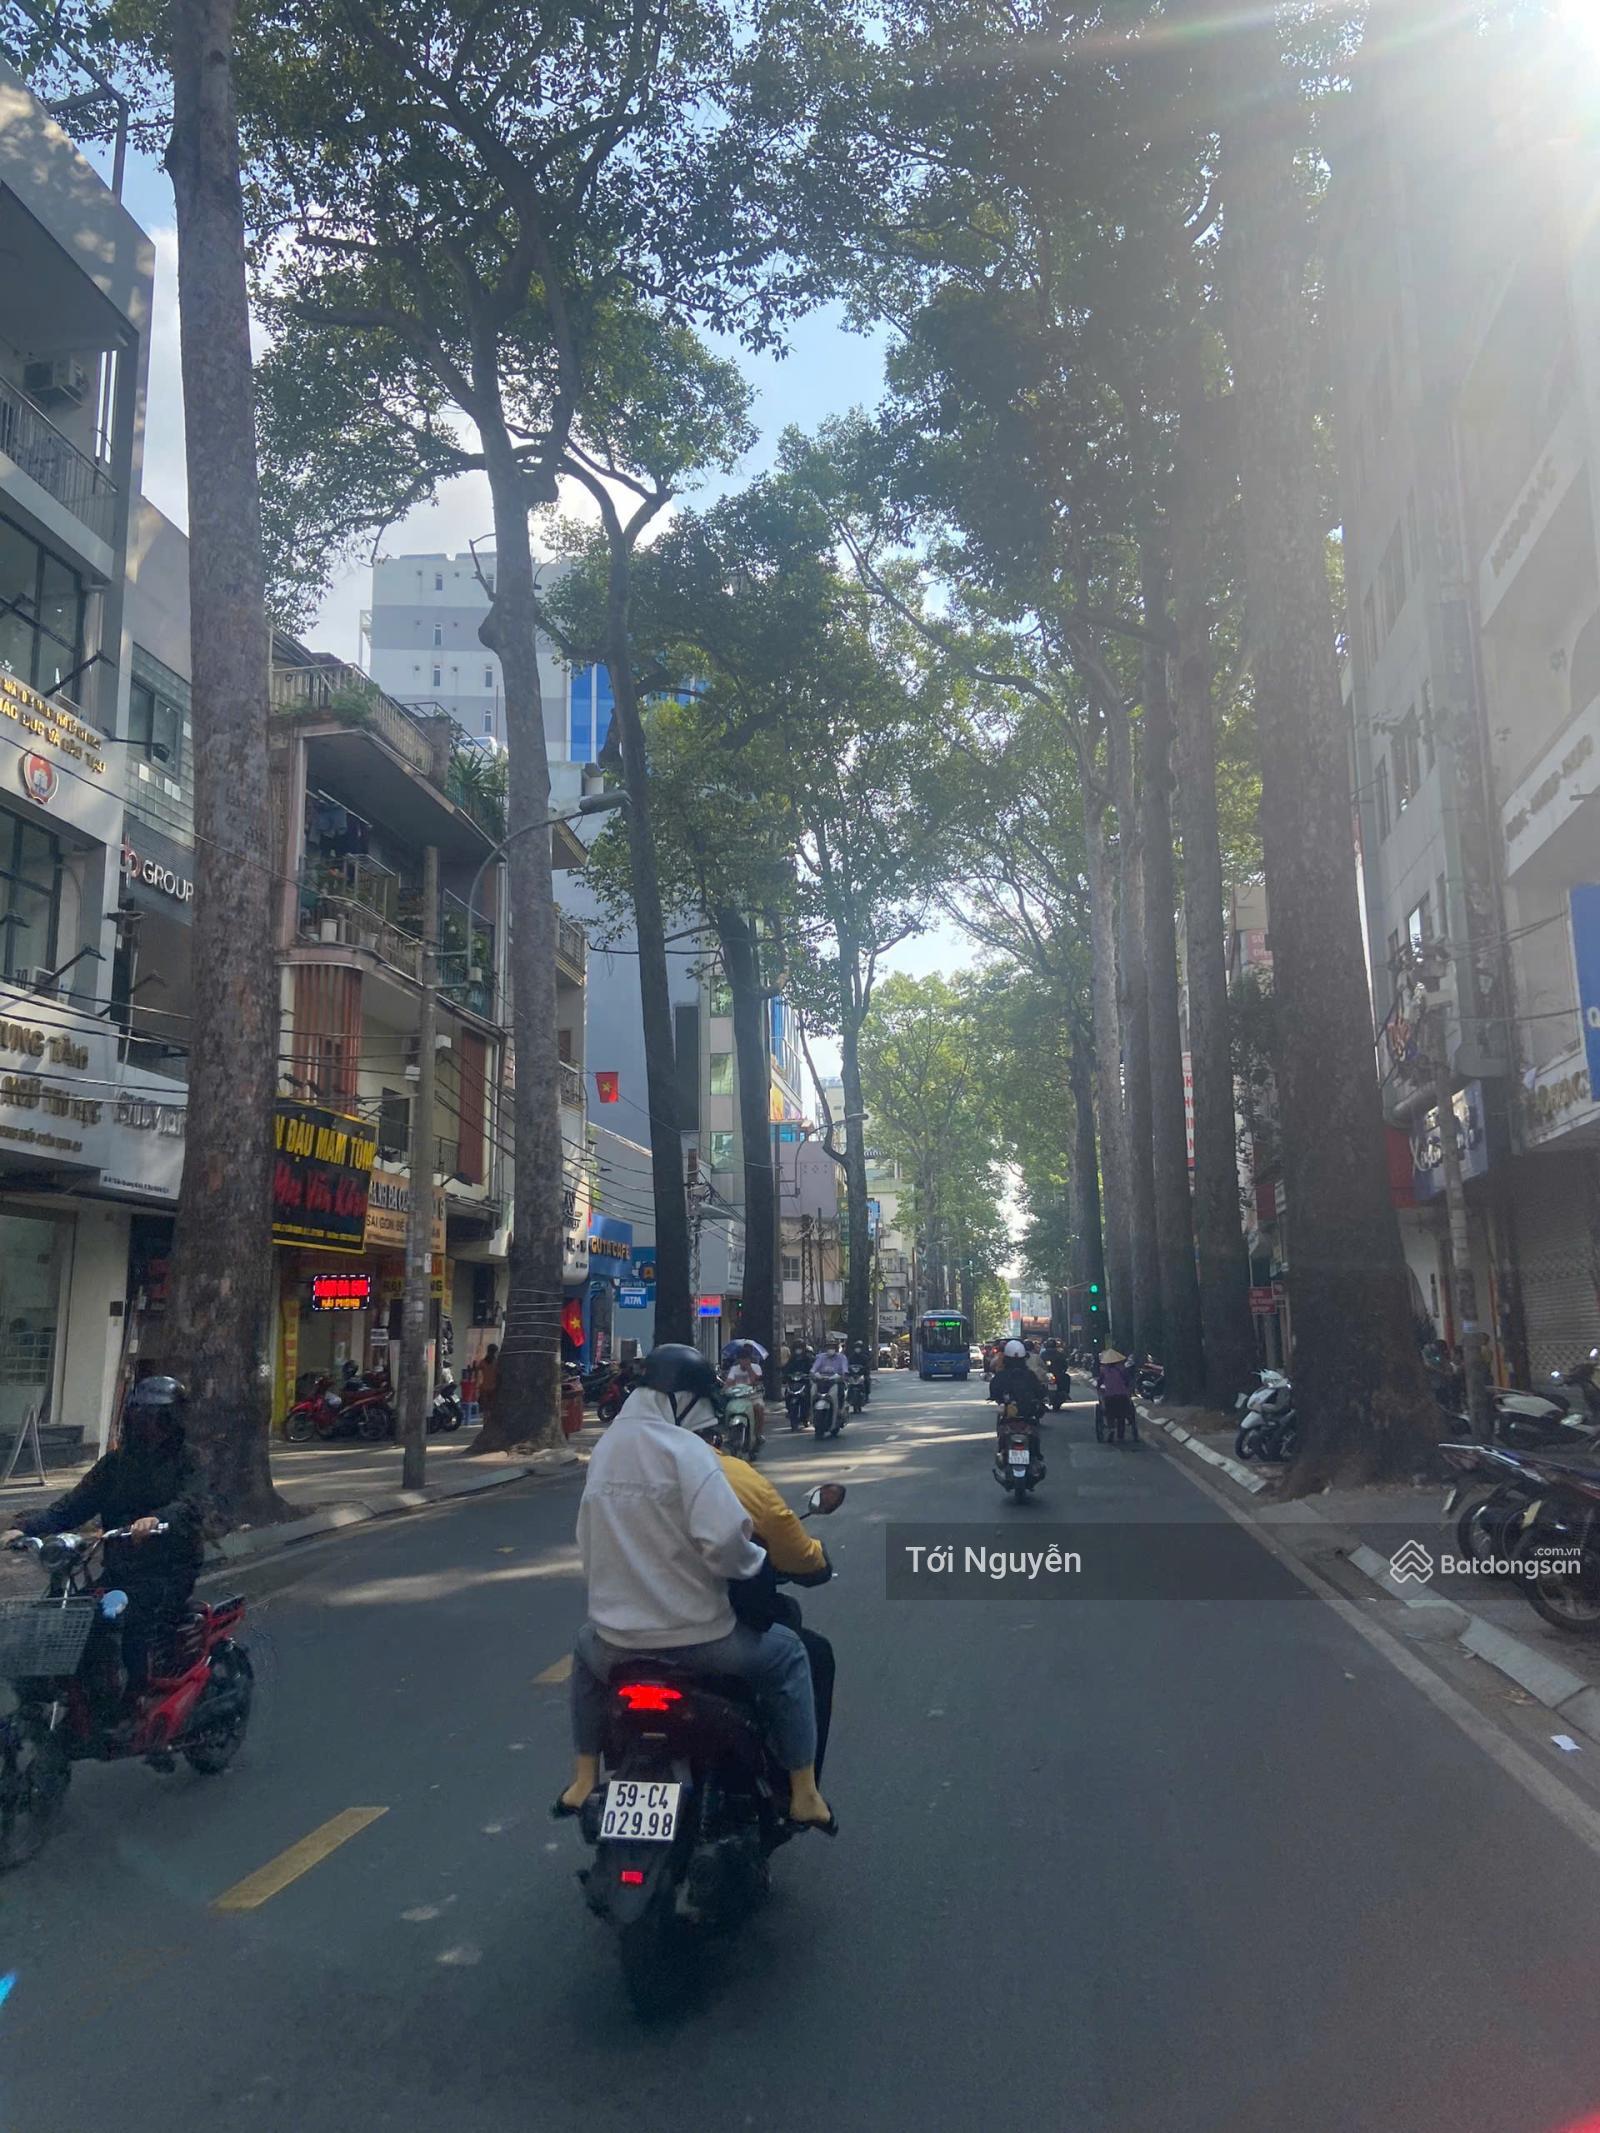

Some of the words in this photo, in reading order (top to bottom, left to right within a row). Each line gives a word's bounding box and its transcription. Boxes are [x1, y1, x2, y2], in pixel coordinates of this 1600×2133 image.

[142, 859, 194, 902] GROUP
[286, 1113, 315, 1162] ĐẬU
[624, 1295, 642, 1305] ATM
[615, 1784, 668, 1808] 59-C4
[604, 1811, 673, 1836] 029.98
